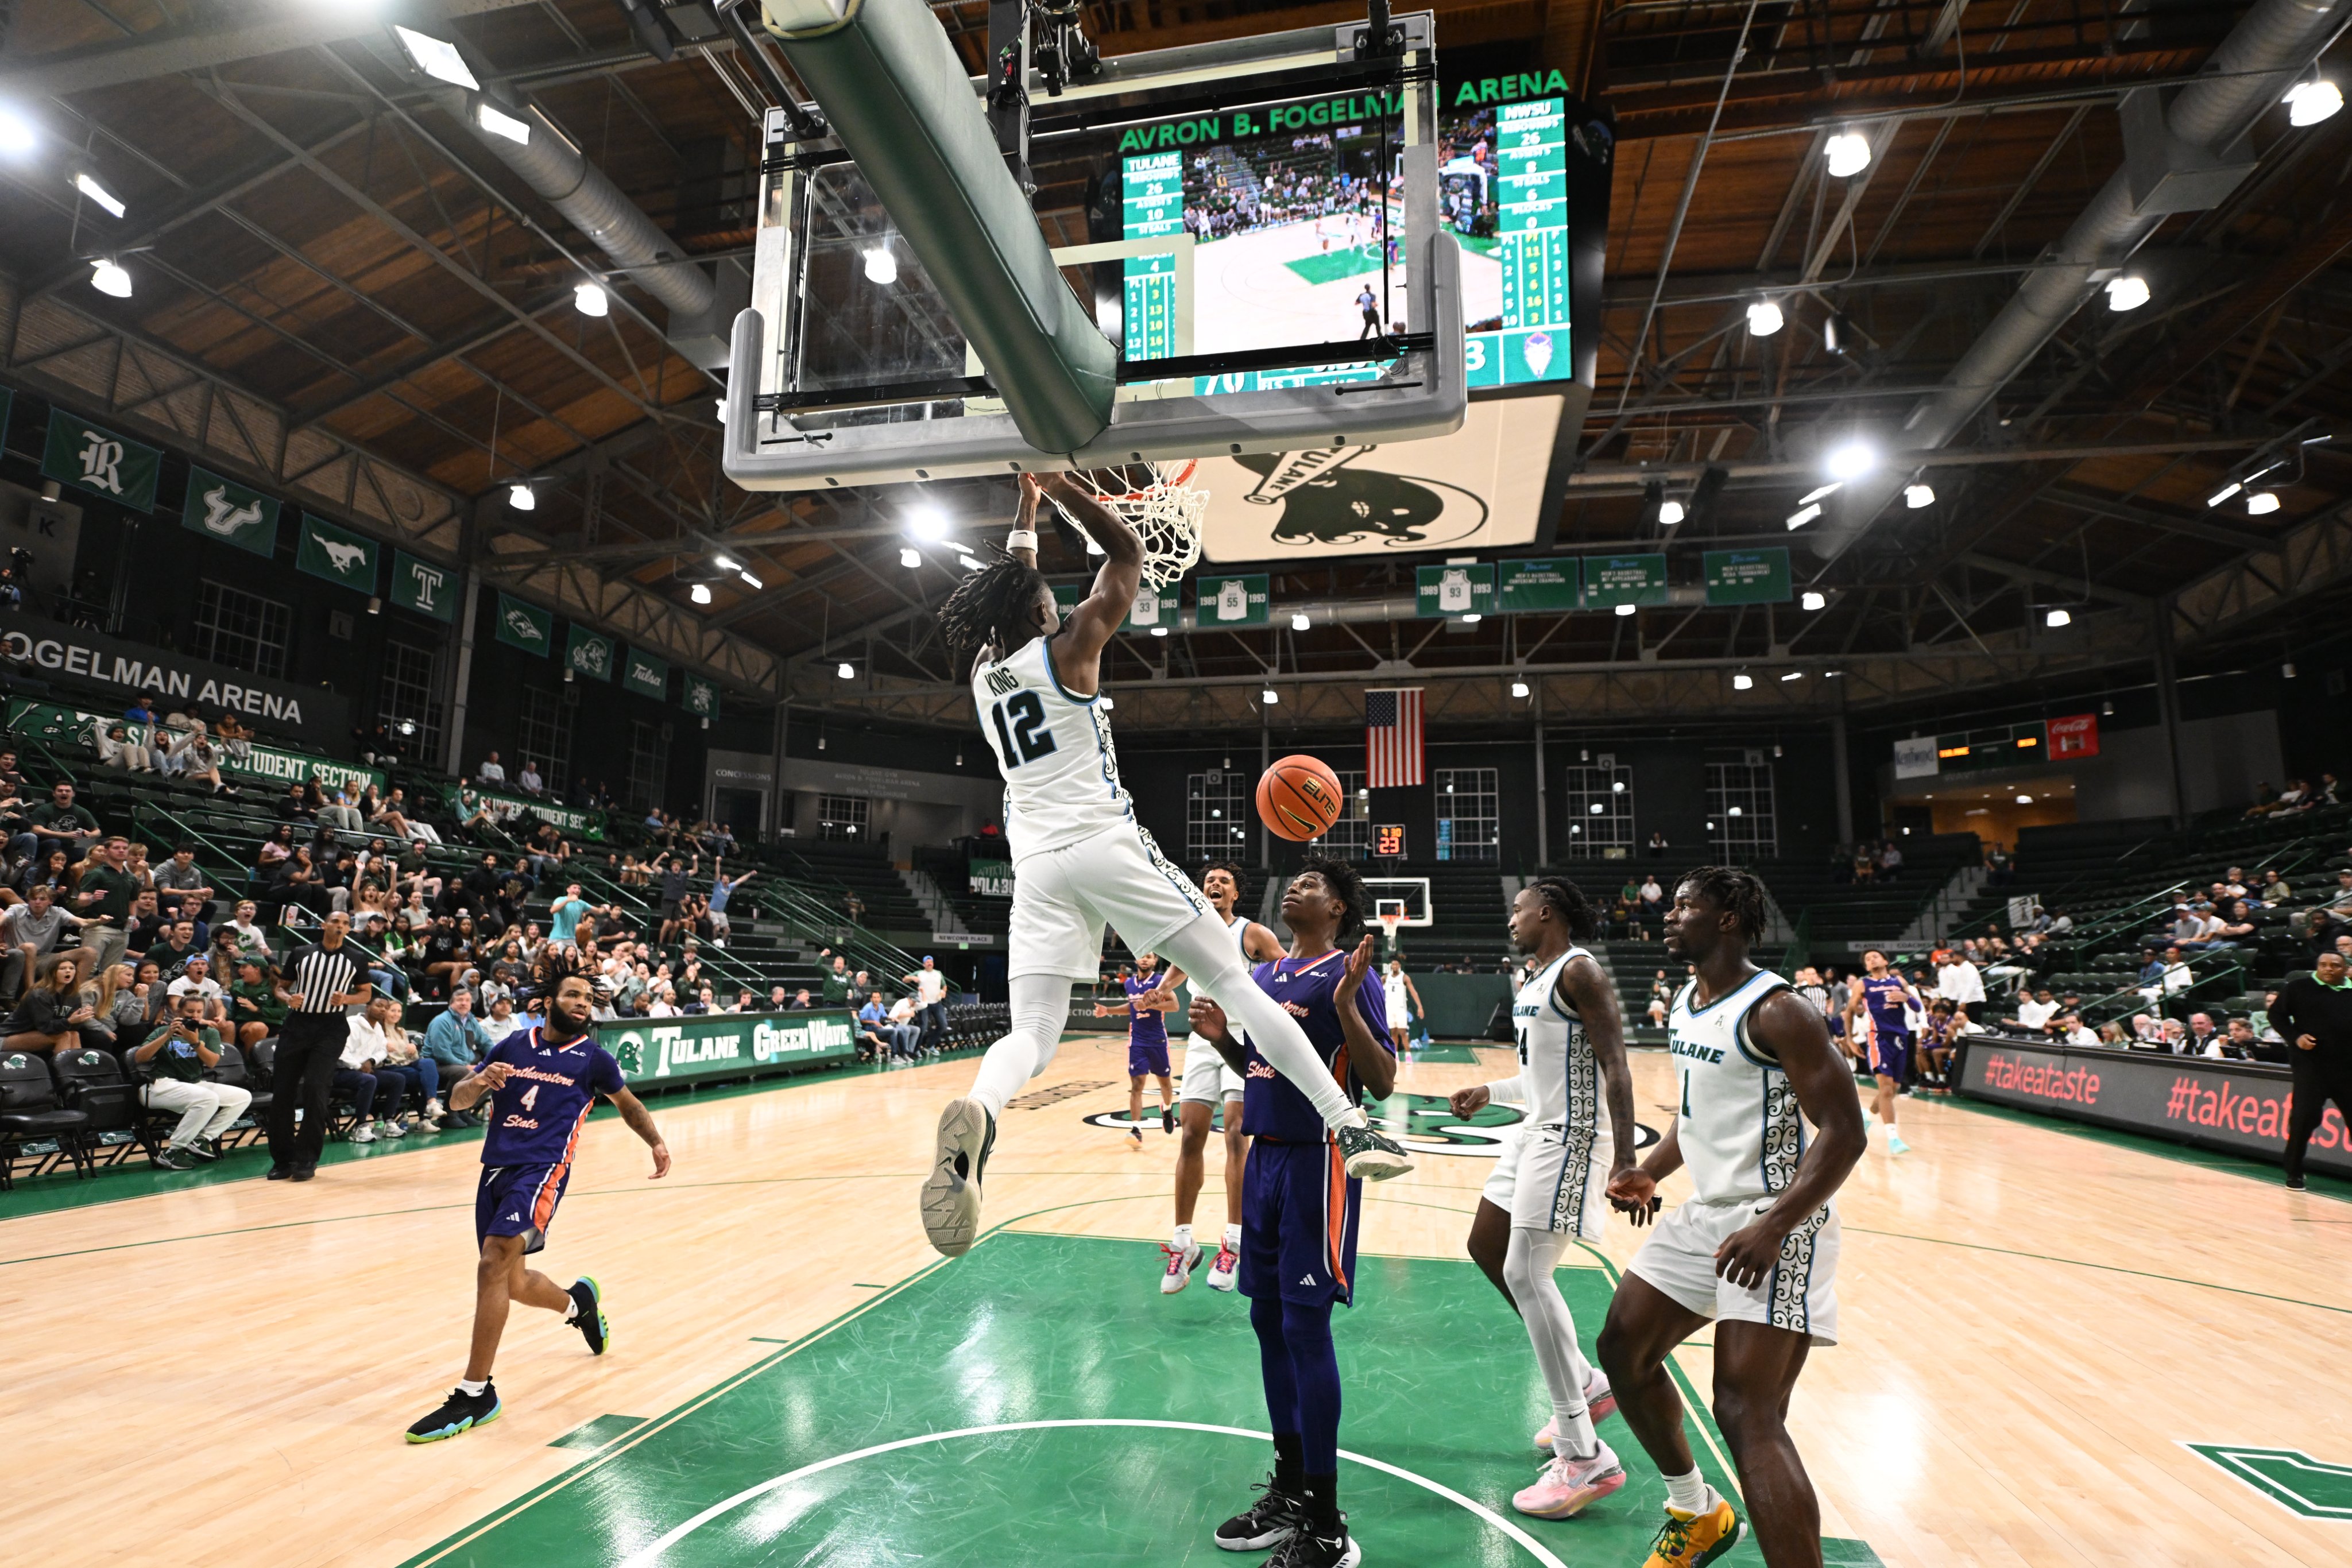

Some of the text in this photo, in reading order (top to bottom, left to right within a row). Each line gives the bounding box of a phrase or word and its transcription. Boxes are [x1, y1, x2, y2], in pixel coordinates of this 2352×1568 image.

[1119, 69, 1569, 152] AVRON B. FOGELMA ARENA
[1504, 101, 1551, 120] NWSU
[1521, 131, 1541, 146] 26
[1128, 153, 1179, 172] TULANE
[1525, 161, 1537, 173] 8
[1146, 182, 1163, 196] 26
[1526, 188, 1538, 202] 6
[1147, 208, 1164, 222] 10
[1526, 216, 1538, 229] 0
[1503, 243, 1561, 260] 1 11 1
[1150, 260, 1160, 272] 4
[1504, 260, 1562, 277] 2 5 3
[1504, 276, 1562, 293] 4 6 1
[1130, 289, 1159, 302] 1 3
[1504, 293, 1563, 309] 5 16 3
[1130, 304, 1163, 318] 2 13
[1502, 309, 1563, 327] 10 3 1
[1130, 320, 1163, 333] 5 10
[1128, 335, 1163, 349] 12 16
[1270, 447, 1345, 491] ULANE
[38, 517, 55, 538] K
[412, 563, 443, 611] T
[1419, 585, 1438, 596] 1989
[1449, 587, 1461, 598] 93
[1473, 583, 1492, 594] 1993
[1160, 599, 1178, 609] 1983
[1199, 596, 1217, 606] 1989
[1227, 597, 1238, 608] 55
[1248, 593, 1266, 603] 1993
[1139, 603, 1150, 613] 33
[0, 630, 301, 725] OGELMAN ARENA
[632, 663, 662, 687] Tulsa
[984, 667, 1019, 697] KING
[992, 688, 1058, 771] 12
[1301, 779, 1336, 818] ELITE
[1379, 837, 1399, 854] 23
[1068, 1008, 1095, 1017] ECTIO
[1512, 1005, 1539, 1018] ULANE
[651, 1026, 741, 1077] TULANE
[1246, 1060, 1276, 1079] State
[1984, 1054, 2101, 1105] #takeataste
[520, 1085, 539, 1112] 4
[1681, 1068, 1691, 1119] 1
[502, 1114, 539, 1129] State
